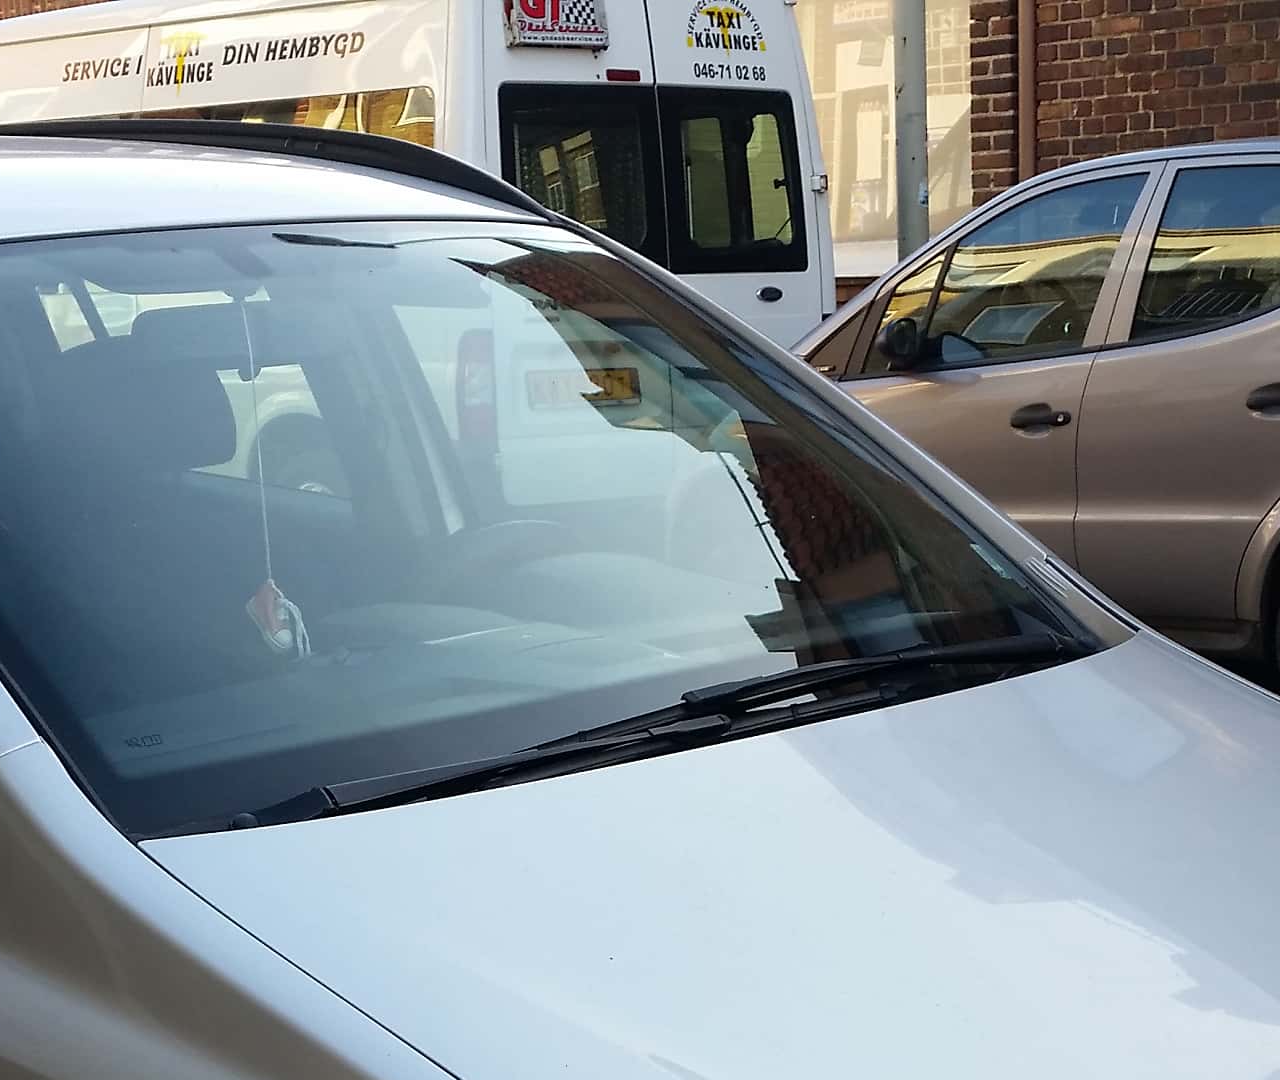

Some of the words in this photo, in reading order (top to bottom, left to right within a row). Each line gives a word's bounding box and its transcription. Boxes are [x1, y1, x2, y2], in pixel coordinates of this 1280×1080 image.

[706, 11, 741, 29] TAXI
[695, 28, 758, 51] KÄVLINGE
[62, 57, 130, 82] SERVICE
[135, 54, 143, 75] I
[222, 44, 259, 66] DIN
[264, 31, 365, 62] HEMBYGD
[146, 61, 214, 87] KÄVLINGE
[694, 63, 732, 80] 046-71
[735, 65, 750, 81] 02
[752, 66, 767, 81] 68
